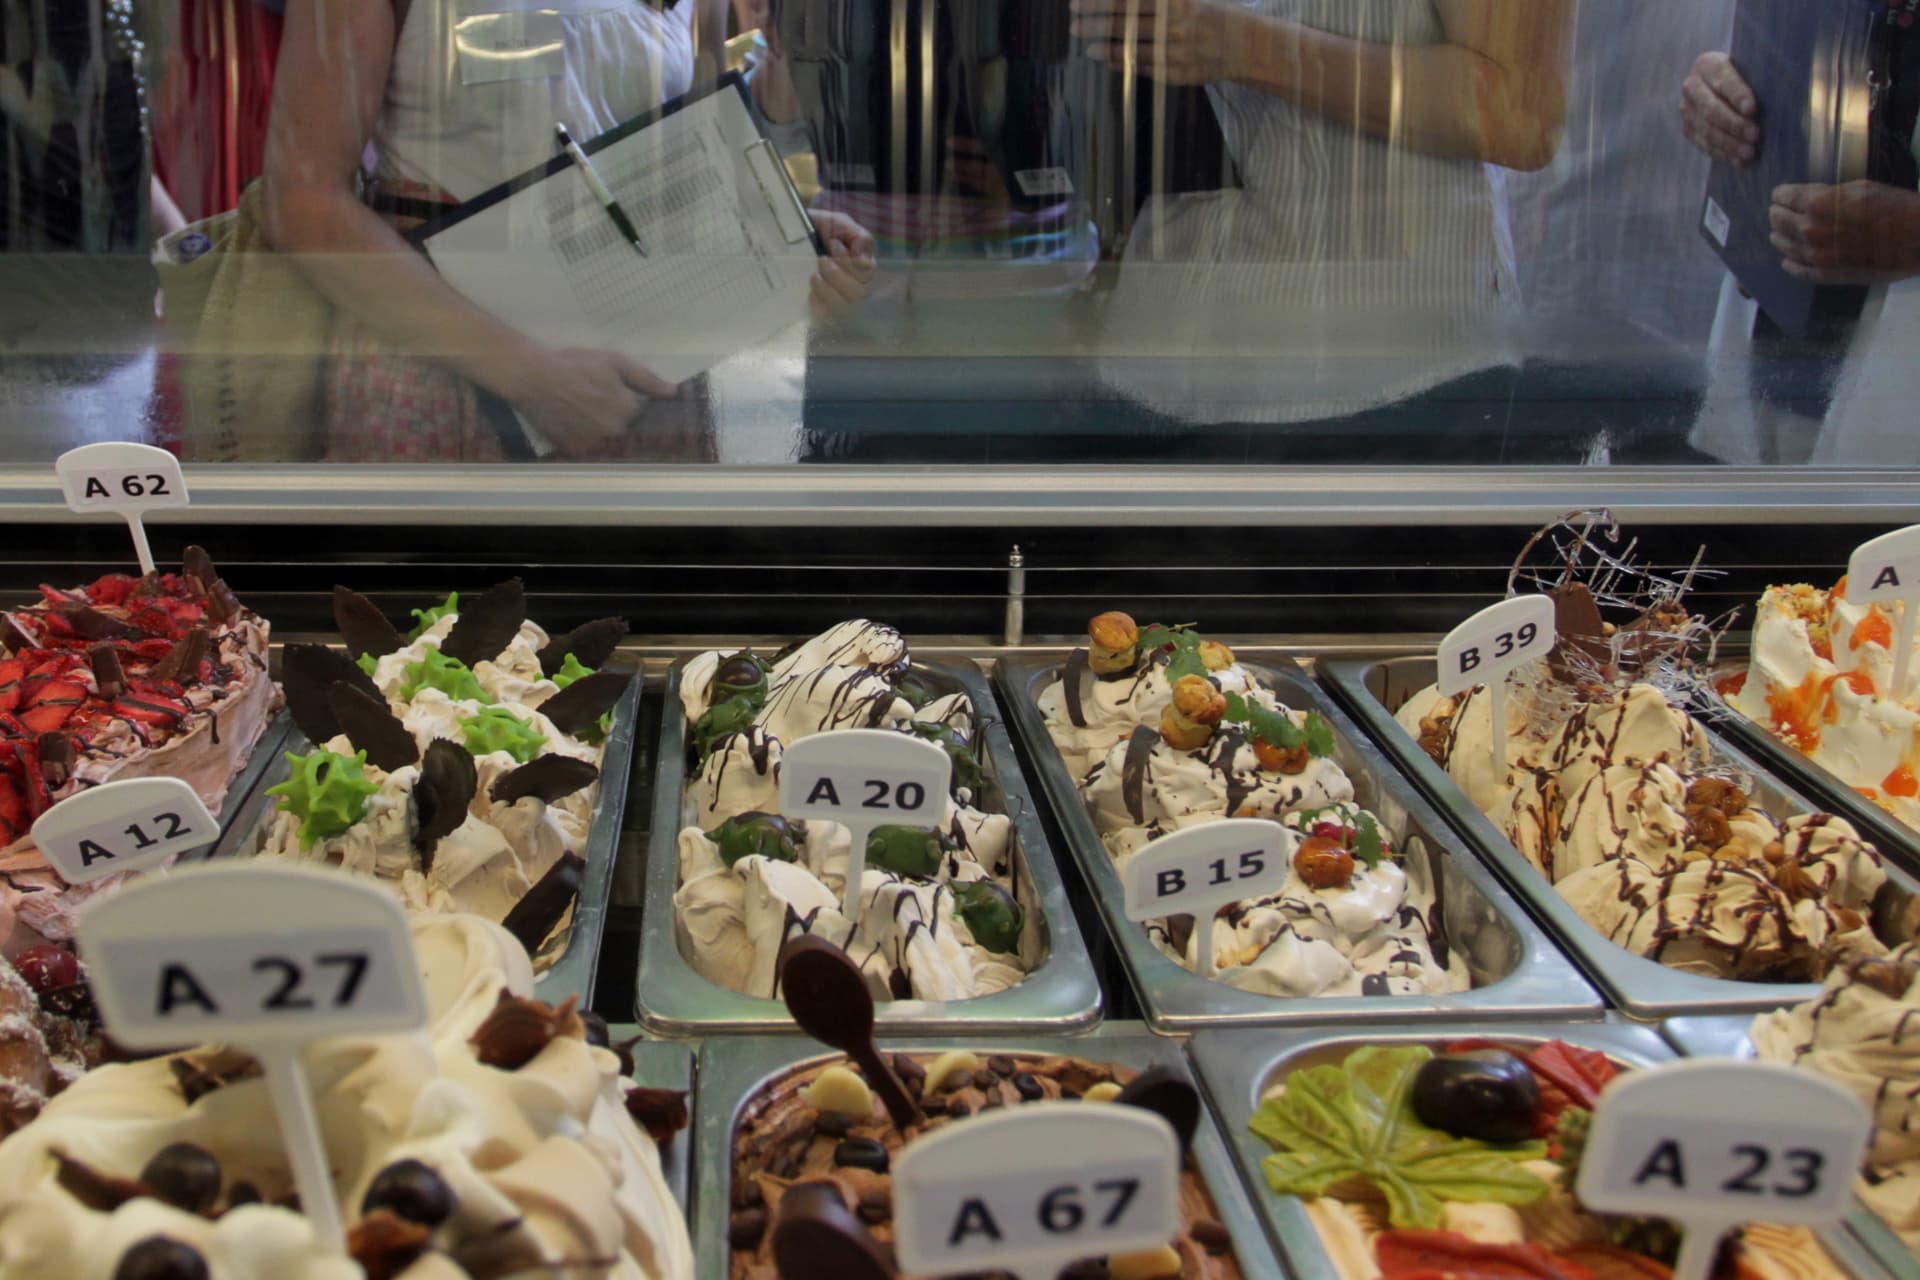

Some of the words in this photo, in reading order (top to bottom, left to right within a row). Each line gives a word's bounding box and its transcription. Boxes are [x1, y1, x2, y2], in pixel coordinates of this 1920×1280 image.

[86, 476, 111, 499] A
[122, 474, 171, 497] 62
[1871, 565, 1900, 590] A
[1459, 647, 1481, 674] B
[1494, 622, 1537, 658] 39
[805, 777, 841, 806] A
[861, 779, 925, 811] 20
[78, 839, 116, 868] A
[123, 812, 192, 850] 12
[1156, 868, 1187, 898] B
[1208, 849, 1265, 886] 15
[156, 963, 219, 1017] A
[252, 953, 370, 1011] 27
[1633, 1139, 1687, 1189] A
[1722, 1144, 1825, 1199] 23
[948, 1197, 1003, 1247] A
[1036, 1178, 1140, 1235] 67
